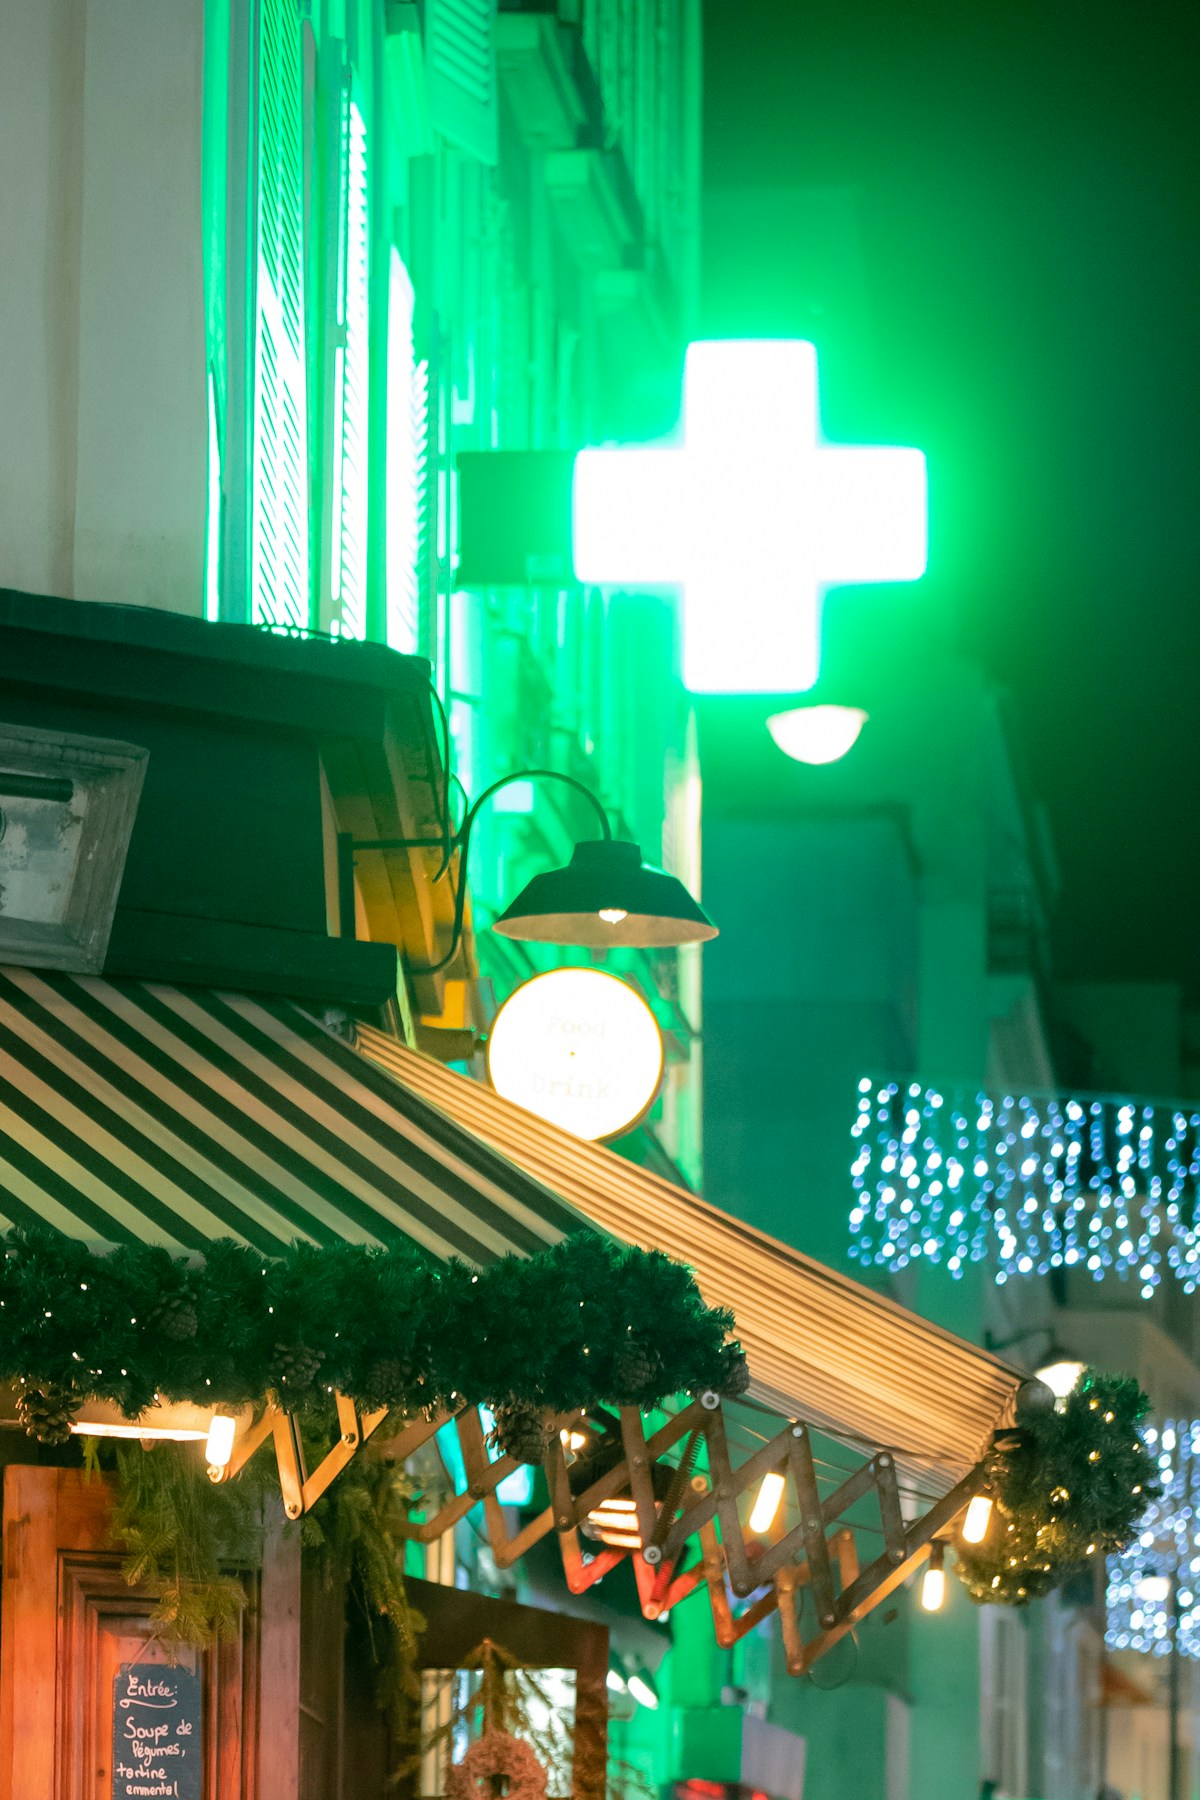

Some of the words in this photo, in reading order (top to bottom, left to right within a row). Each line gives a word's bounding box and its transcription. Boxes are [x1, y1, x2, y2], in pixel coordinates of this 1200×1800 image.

[123, 1716, 169, 1745] Soupe
[176, 1719, 193, 1736] de
[116, 1761, 168, 1780] tartine
[125, 1781, 179, 1798] emmental
